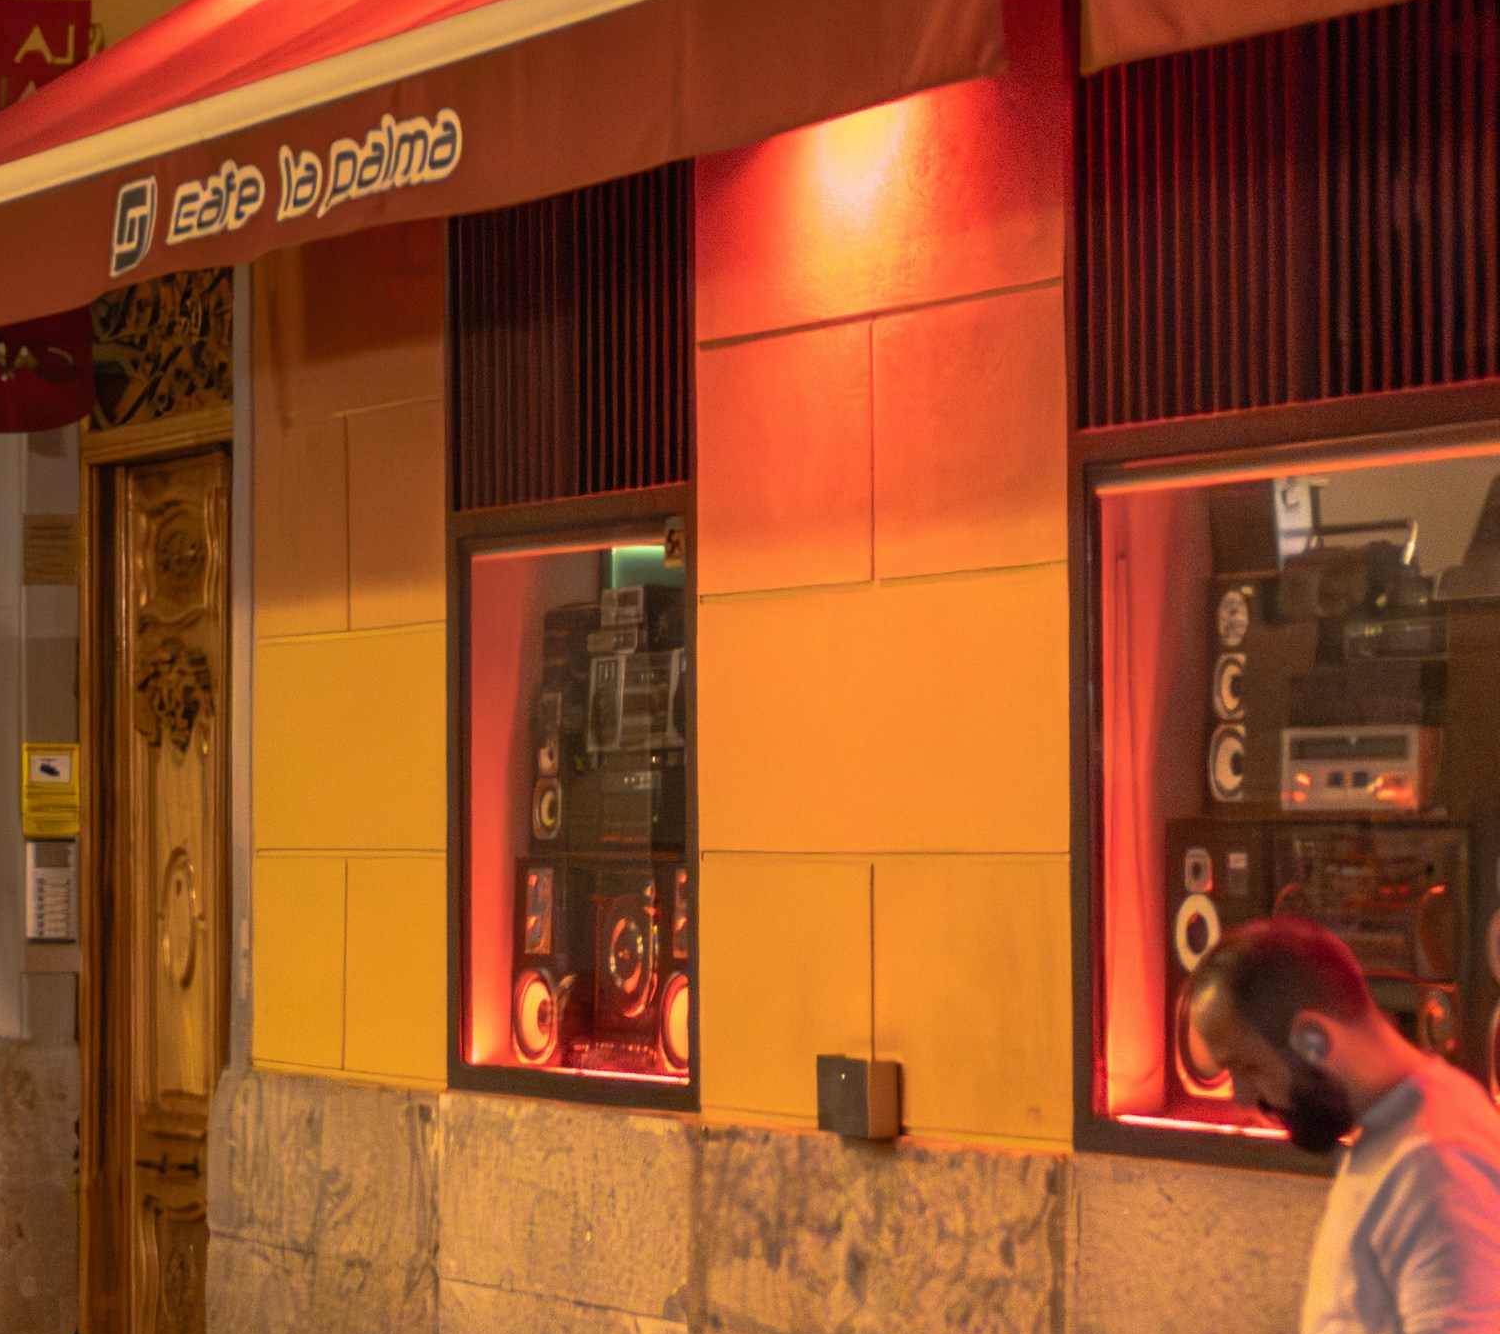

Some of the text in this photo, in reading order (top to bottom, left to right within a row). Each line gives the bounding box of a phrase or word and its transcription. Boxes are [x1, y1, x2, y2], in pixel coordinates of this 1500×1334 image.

[166, 108, 462, 246] cafe la palma
